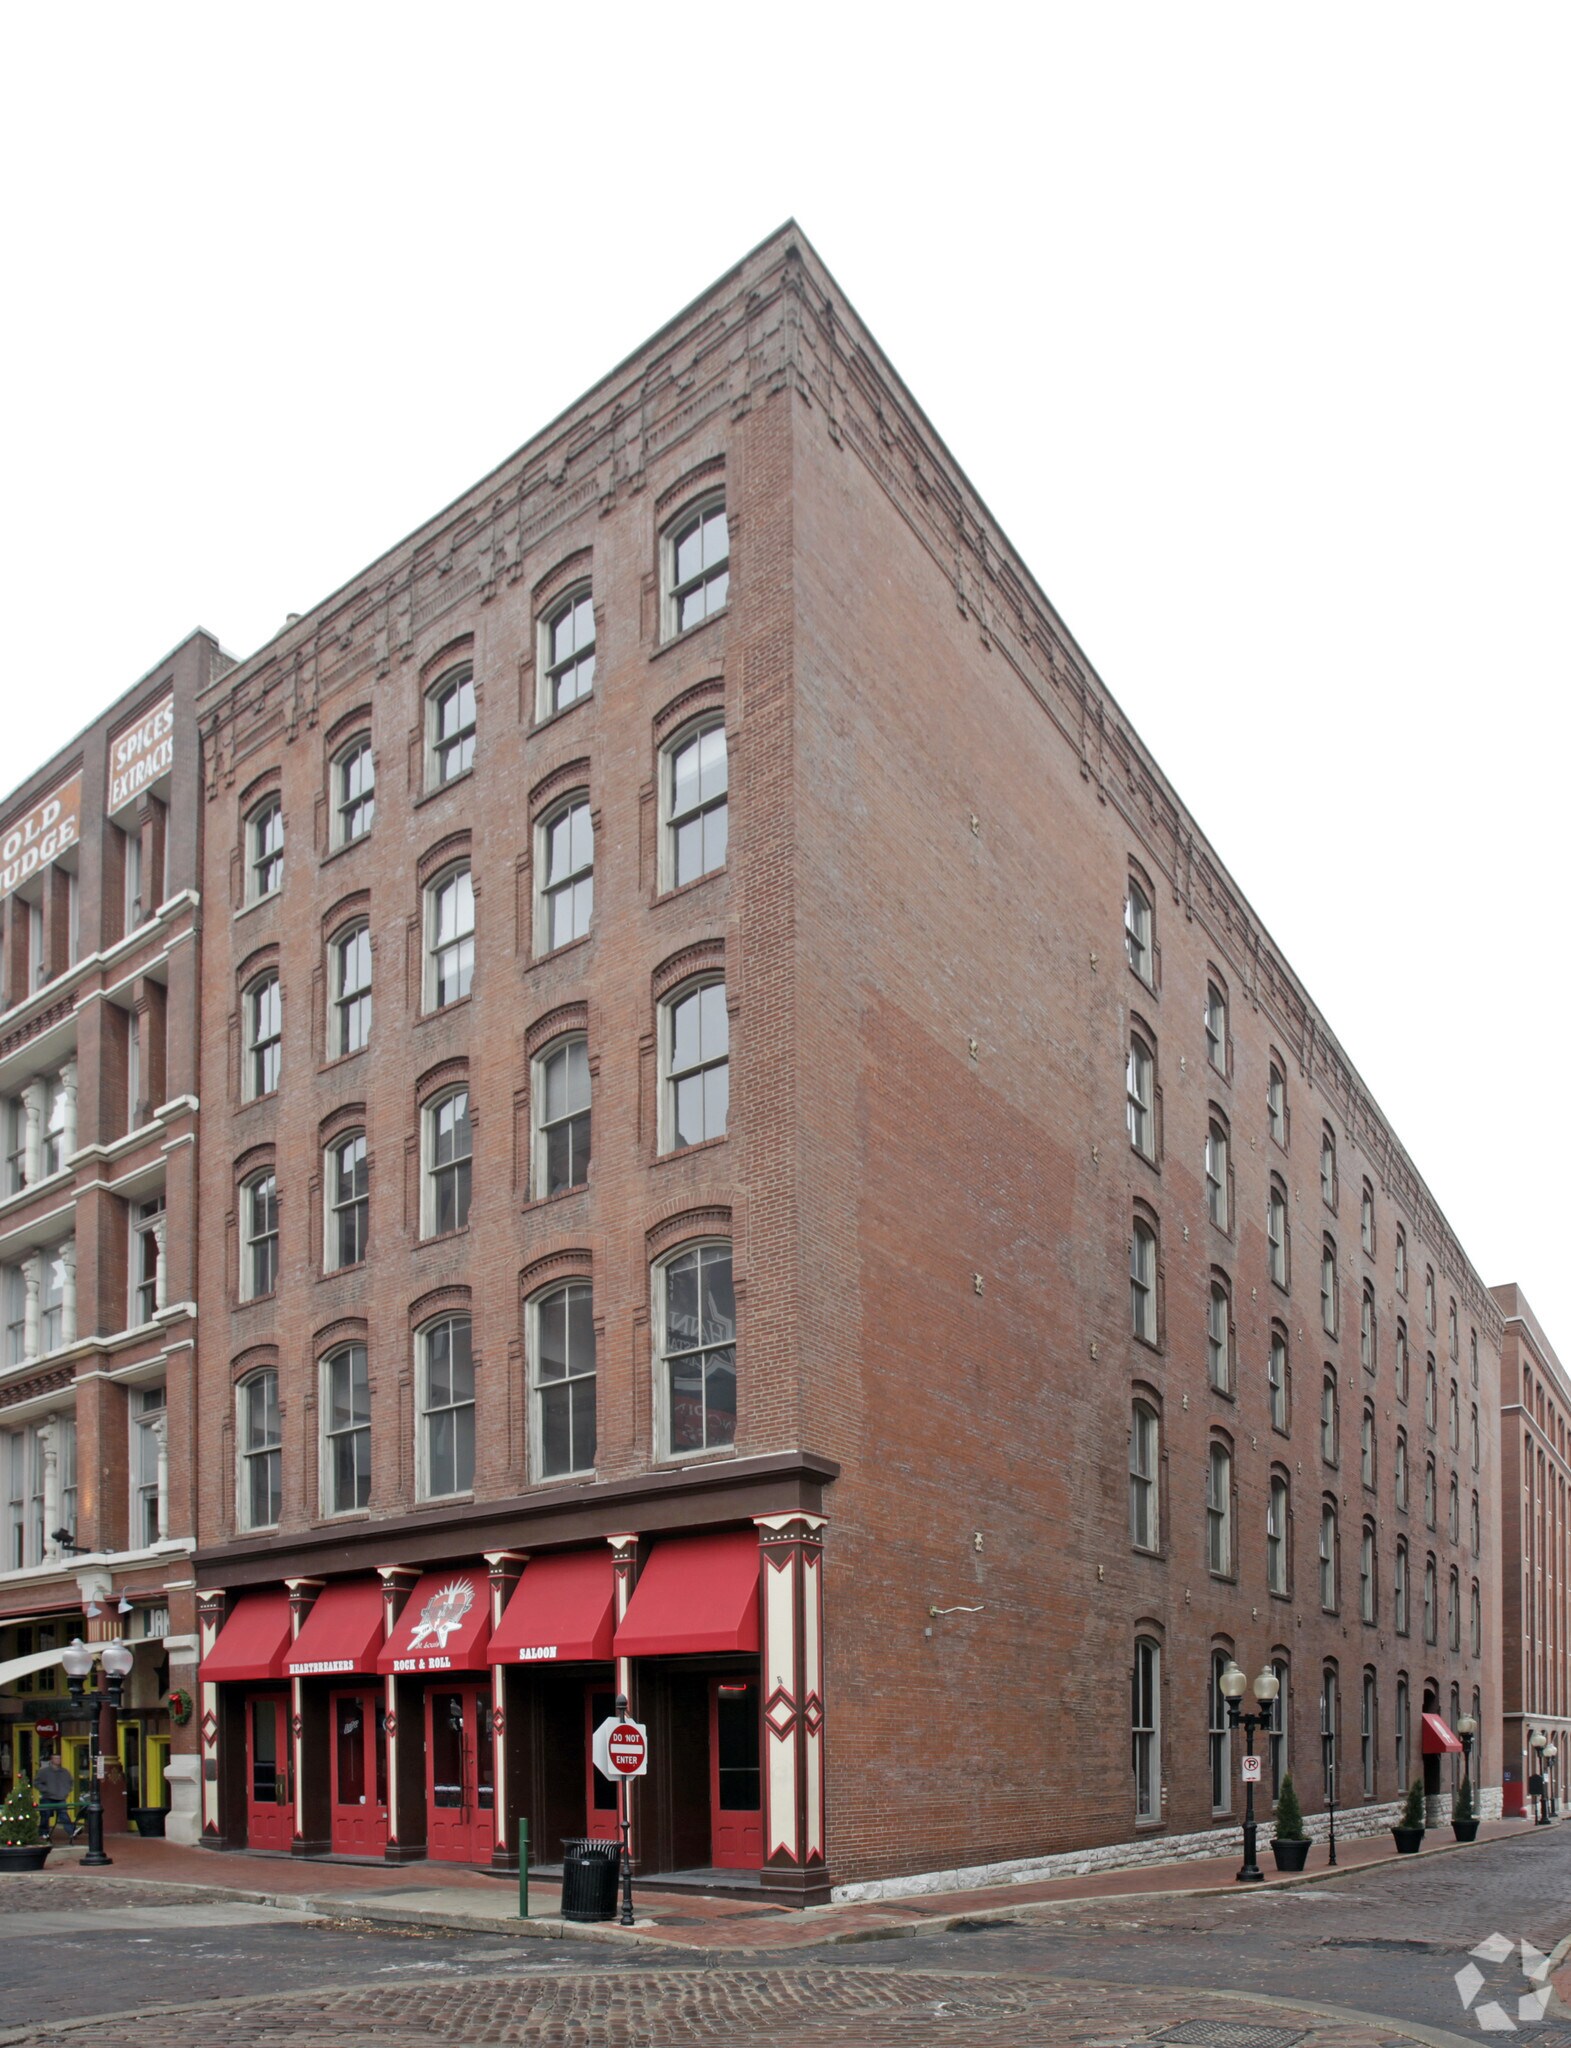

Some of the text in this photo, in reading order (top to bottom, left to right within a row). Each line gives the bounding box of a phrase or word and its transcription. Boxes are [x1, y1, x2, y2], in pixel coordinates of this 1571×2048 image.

[116, 702, 174, 770] SPICES
[112, 735, 174, 804] EXTRACTS
[3, 799, 61, 861] OLD
[0, 815, 75, 889] UDGE
[519, 1646, 557, 1660] SALOON
[289, 1660, 354, 1674] HEARTBREAKERS
[393, 1656, 451, 1671] ROCK & ROLL
[613, 1733, 640, 1742] DO NOT
[616, 1755, 638, 1765] ENTER
